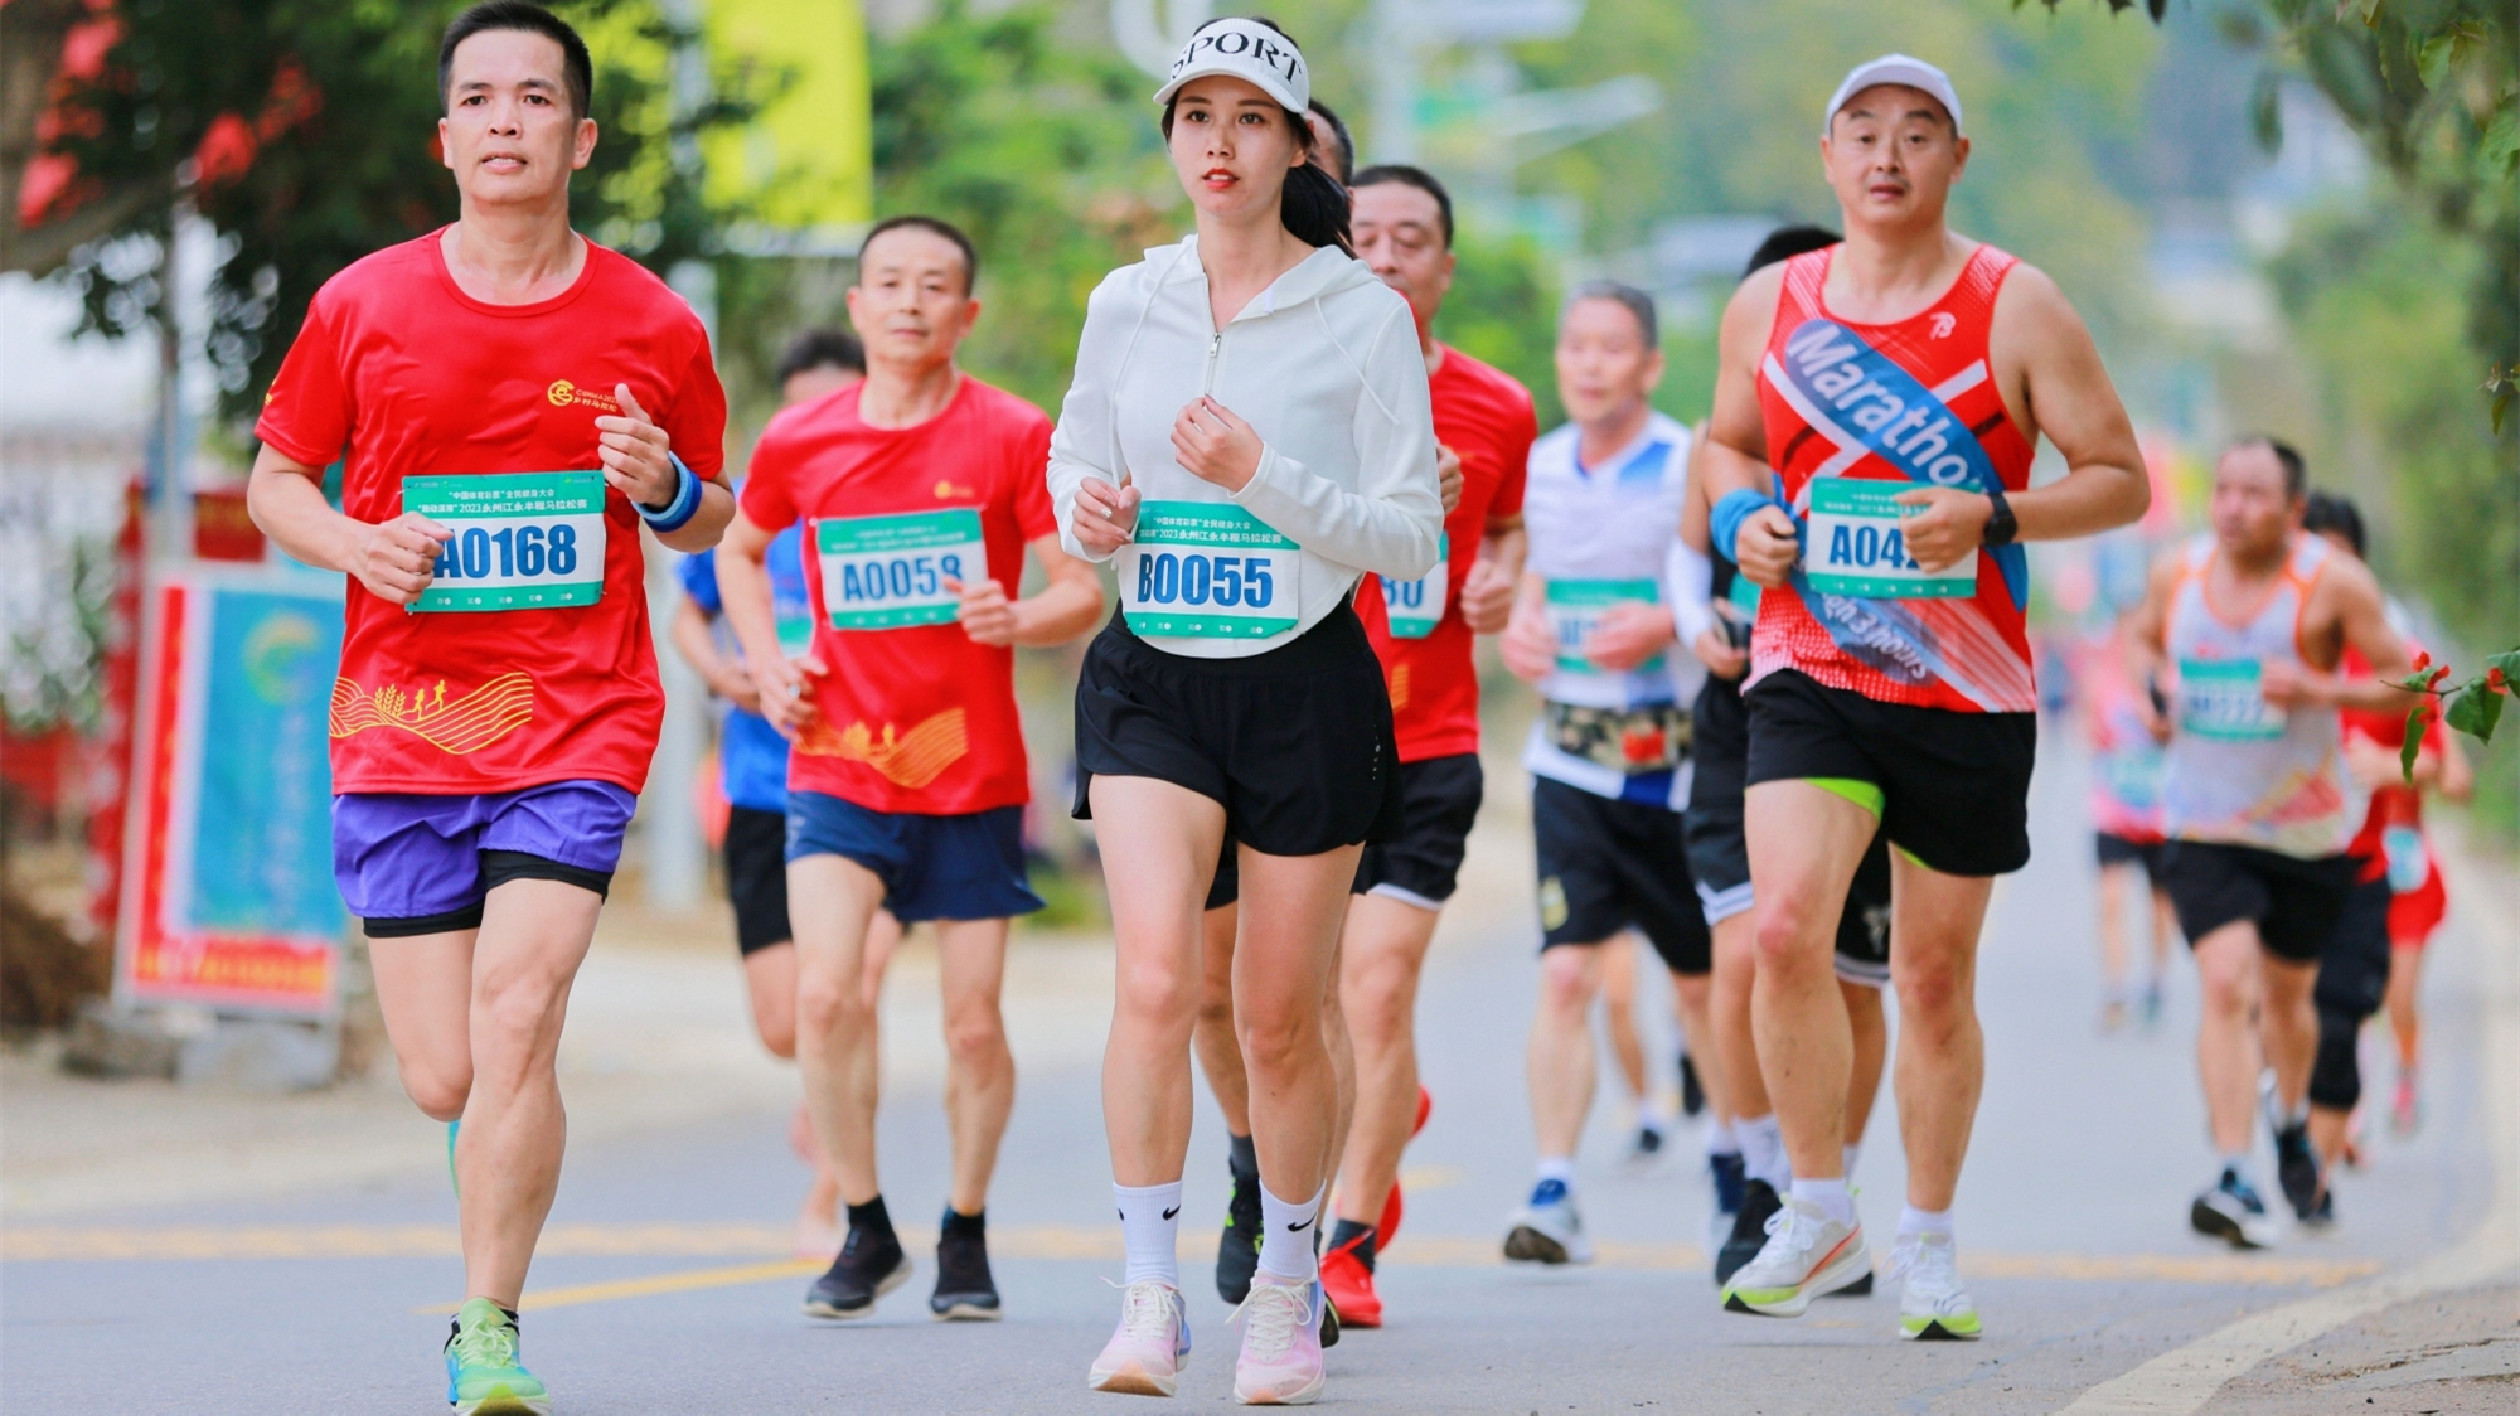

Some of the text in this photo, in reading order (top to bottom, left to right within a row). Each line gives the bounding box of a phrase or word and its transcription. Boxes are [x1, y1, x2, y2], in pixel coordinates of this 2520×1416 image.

[433, 523, 577, 579] A0168
[1829, 524, 1920, 569] A04
[1138, 553, 1273, 608] B0055
